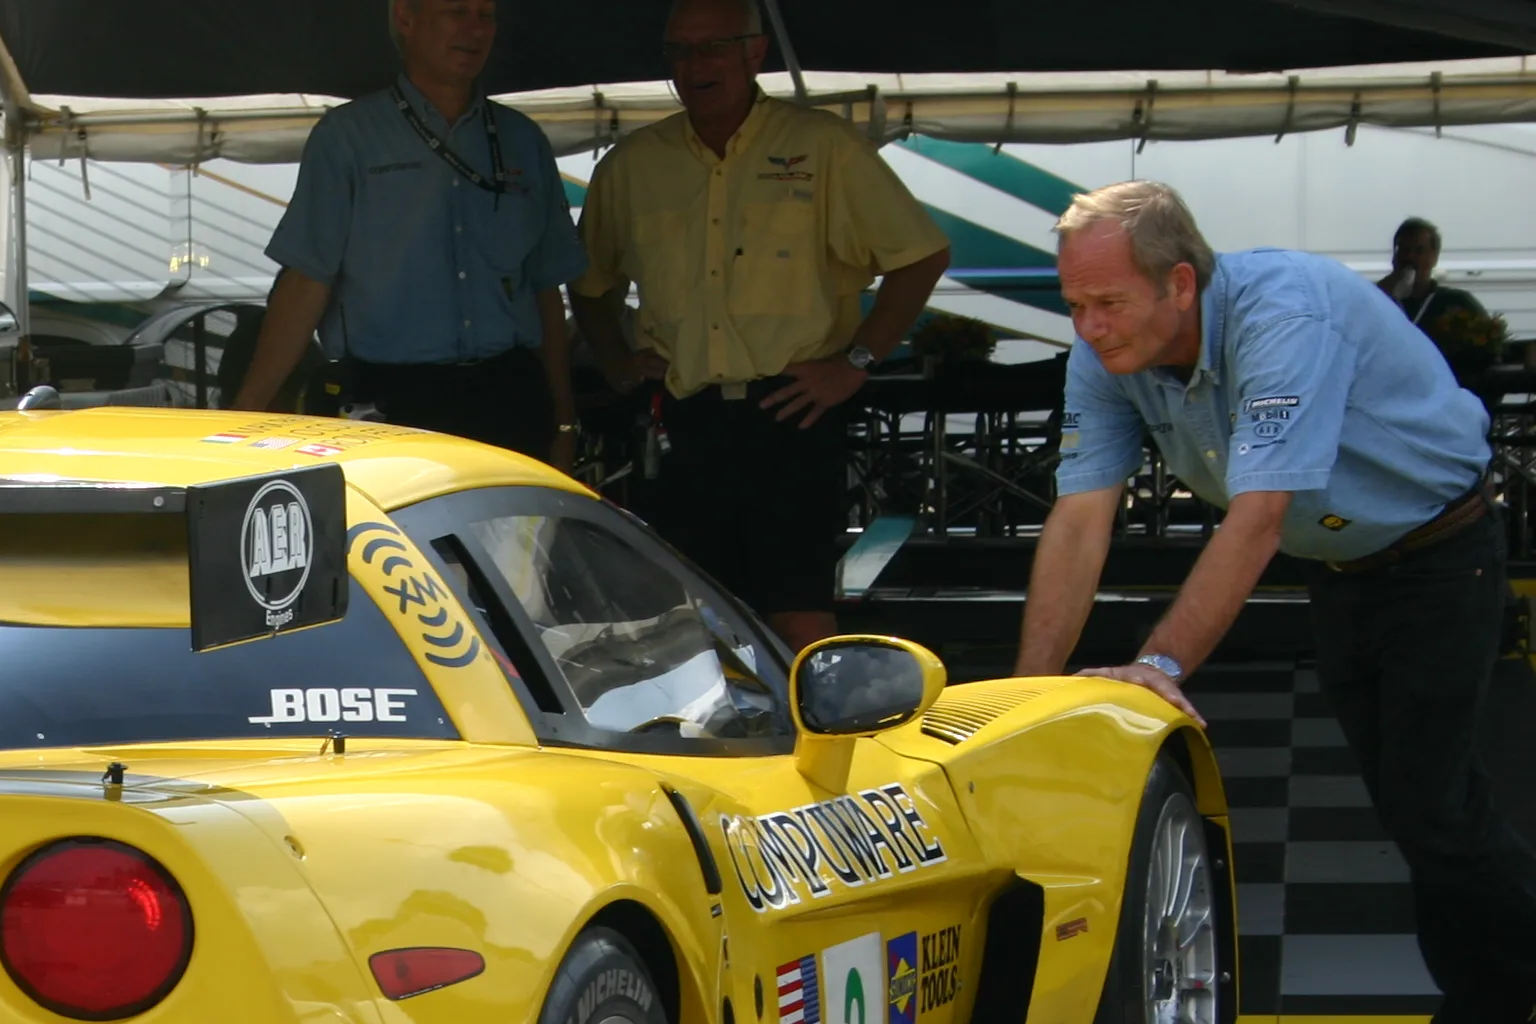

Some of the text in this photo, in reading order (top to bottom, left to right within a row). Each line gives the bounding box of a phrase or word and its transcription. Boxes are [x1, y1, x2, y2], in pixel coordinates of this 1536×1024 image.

[250, 501, 306, 577] AER
[382, 571, 449, 615] XM
[265, 608, 294, 631] Engines
[248, 687, 418, 724] BOSE
[718, 780, 948, 914] COMPUWARE
[922, 923, 962, 974] KLEIN
[921, 964, 959, 1014] TOOLS
